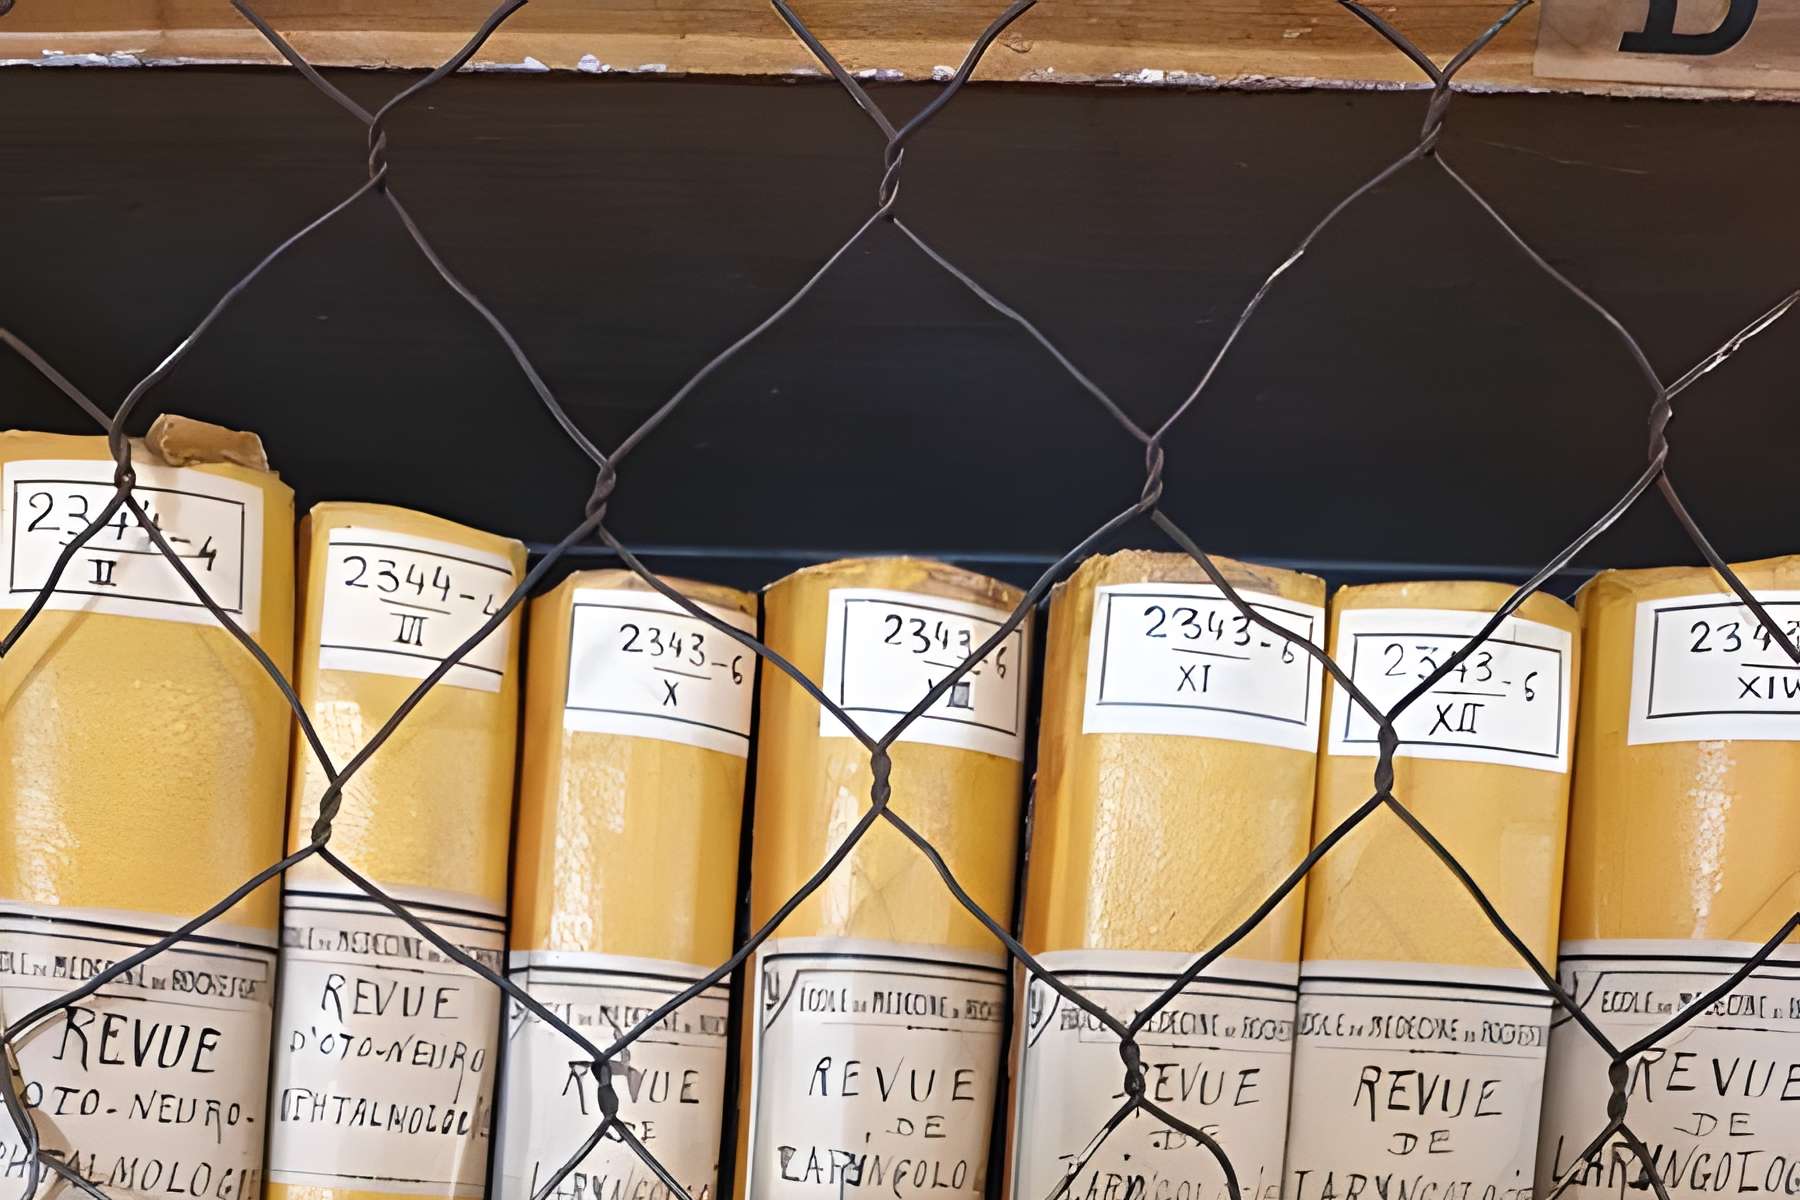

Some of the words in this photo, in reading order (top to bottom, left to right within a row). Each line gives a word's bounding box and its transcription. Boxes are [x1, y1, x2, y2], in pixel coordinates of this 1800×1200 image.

[620, 623, 743, 685] 2343-6
[663, 679, 679, 707] X
[321, 973, 460, 1023] REVUE
[52, 1005, 222, 1072] REVUE
[562, 1060, 700, 1116] RVUE
[808, 1056, 976, 1103] REVUE
[1353, 1065, 1503, 1122] REVUE
[1386, 1129, 1455, 1156] DE
[1673, 1112, 1756, 1137] DE
